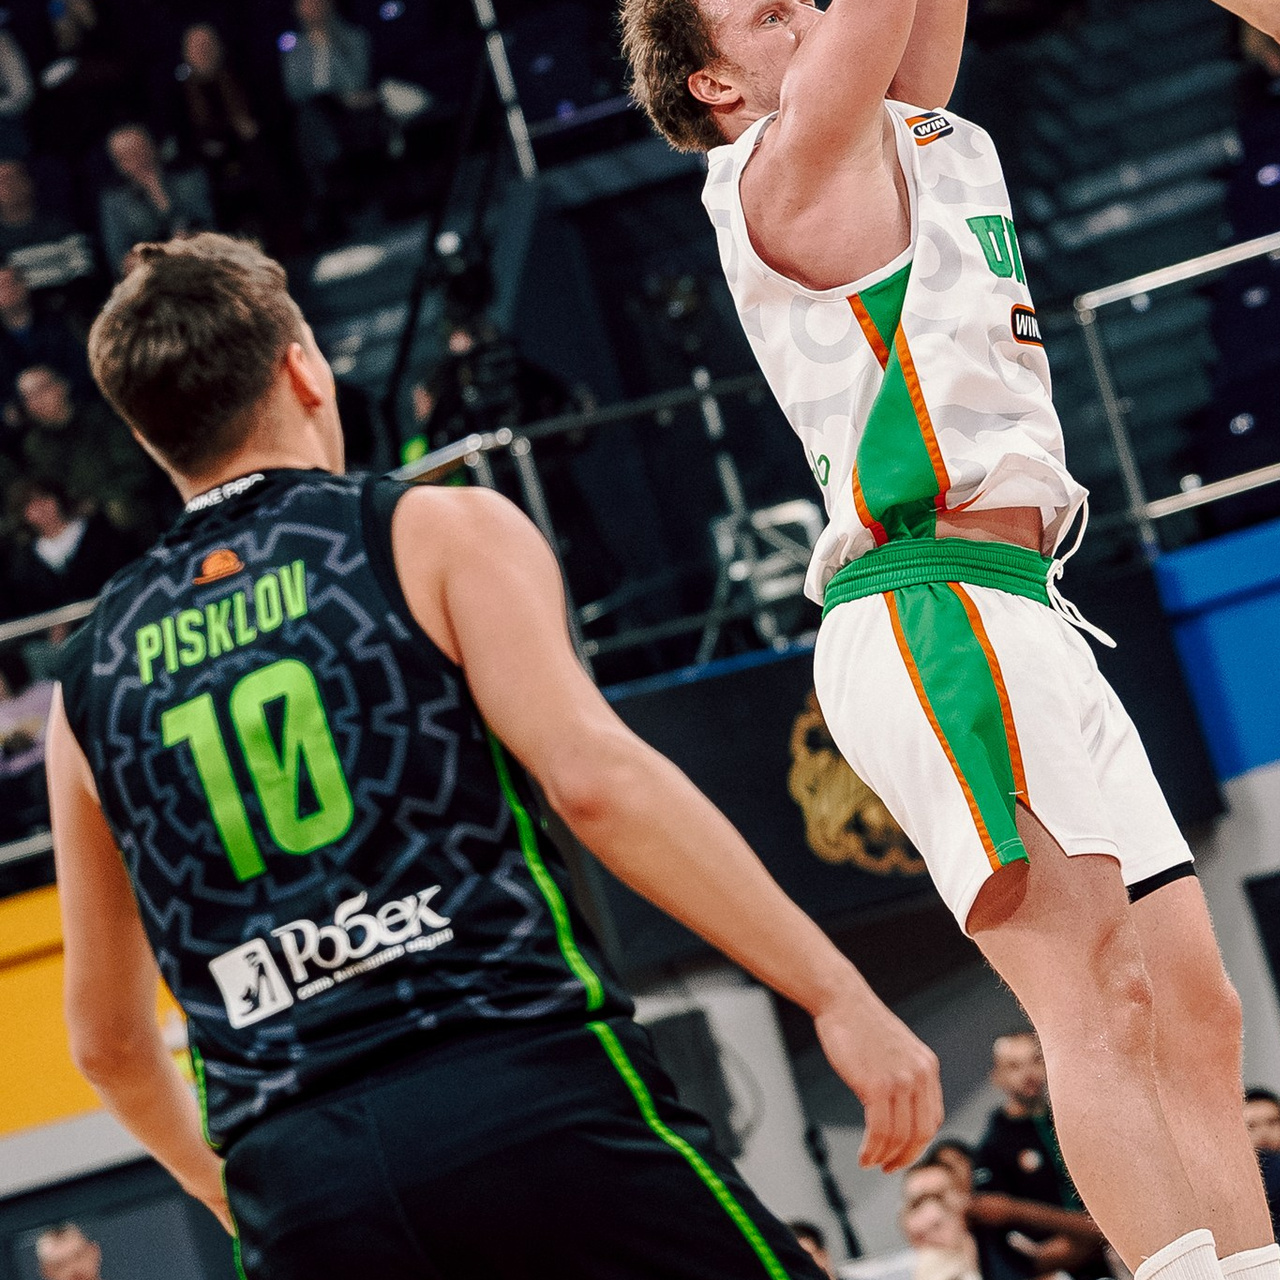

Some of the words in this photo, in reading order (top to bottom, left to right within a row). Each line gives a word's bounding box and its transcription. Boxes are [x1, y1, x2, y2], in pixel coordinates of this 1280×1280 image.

[916, 118, 947, 136] WIN
[135, 559, 308, 685] PISKLOV
[160, 658, 354, 883] 10
[270, 884, 452, 983] Робек
